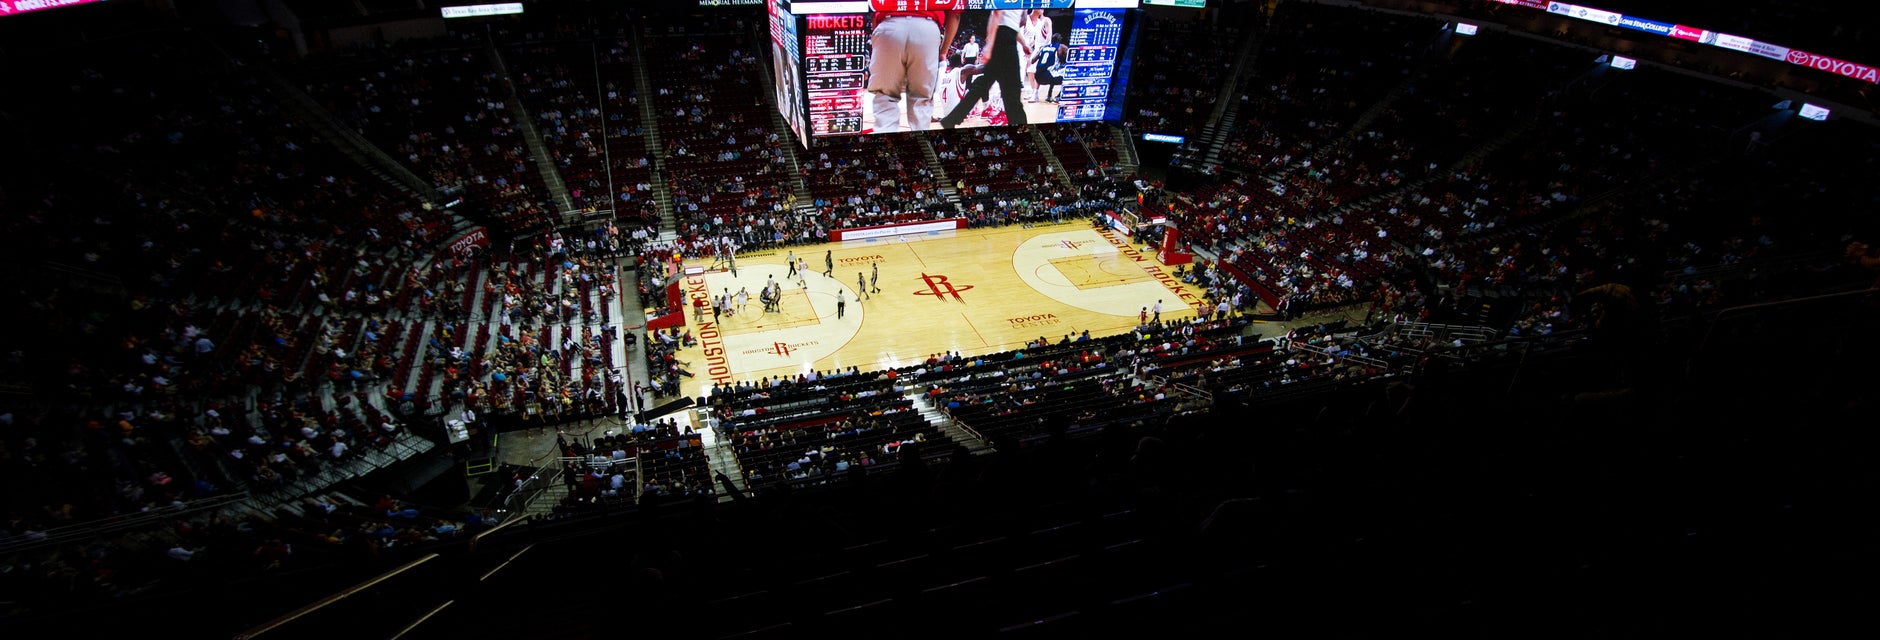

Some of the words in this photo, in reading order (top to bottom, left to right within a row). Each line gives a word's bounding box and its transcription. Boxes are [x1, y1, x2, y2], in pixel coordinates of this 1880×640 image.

[808, 15, 864, 29] ROCKETS
[1619, 17, 1634, 26] LONE
[1809, 55, 1876, 82] TOYOTA
[450, 231, 484, 254] TOYOTA
[1091, 225, 1148, 262] OUSTON
[839, 254, 884, 263] TOYOTA
[1008, 313, 1057, 324] TOYOTA
[697, 322, 732, 386] HOUSTON
